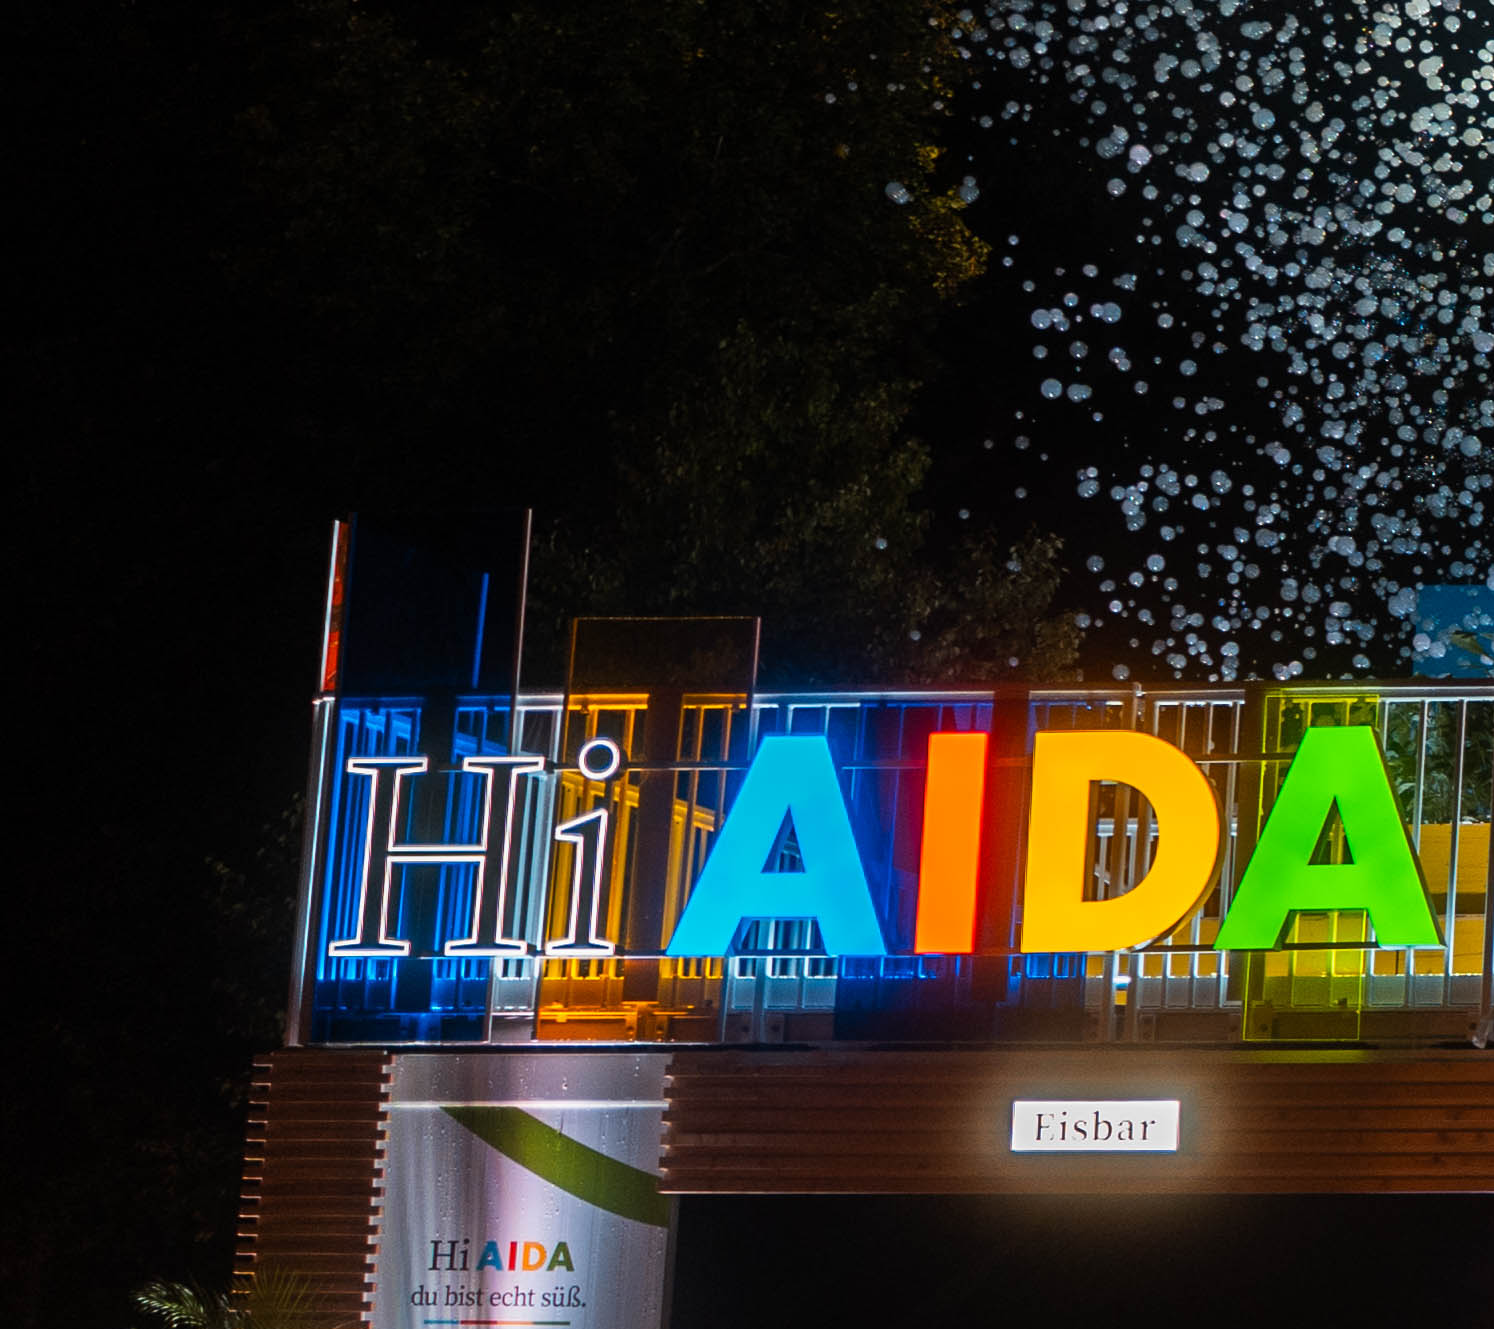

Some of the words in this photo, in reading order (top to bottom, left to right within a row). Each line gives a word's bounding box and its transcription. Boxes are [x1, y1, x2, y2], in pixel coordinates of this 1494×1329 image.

[328, 737, 621, 959] Hi
[667, 725, 1446, 957] AIDA
[1035, 1110, 1157, 1141] Eisbar
[428, 1238, 471, 1272] Hi
[476, 1239, 575, 1272] AIDA
[410, 1285, 438, 1307] du
[444, 1284, 484, 1307] bist
[489, 1285, 536, 1307] echt
[540, 1284, 587, 1308] süß.
